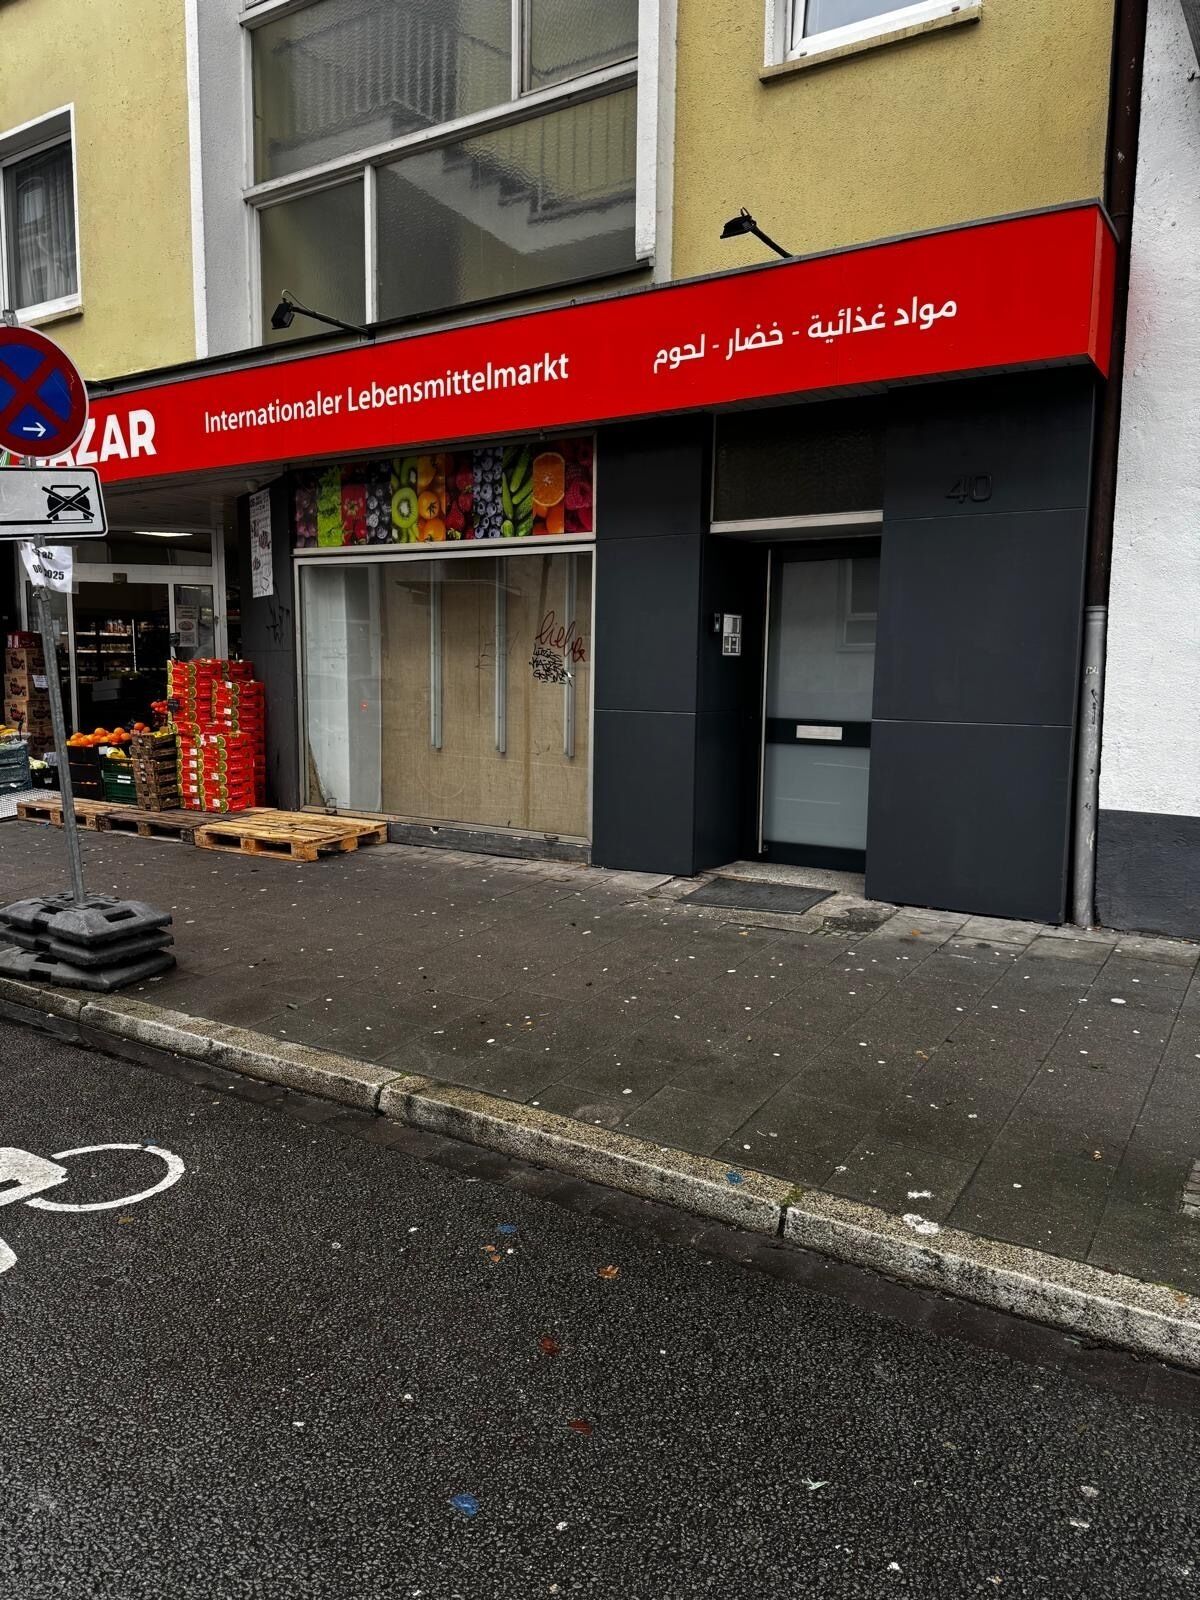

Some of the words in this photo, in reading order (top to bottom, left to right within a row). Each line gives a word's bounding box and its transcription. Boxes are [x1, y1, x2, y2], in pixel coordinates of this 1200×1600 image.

[807, 303, 886, 344] غذائية
[893, 296, 957, 330] مواد
[653, 333, 706, 374] لحوم
[726, 321, 784, 361] خضار
[205, 390, 343, 434] Internationaler
[347, 352, 569, 412] Lebensmittelmarkt
[944, 474, 993, 504] 40
